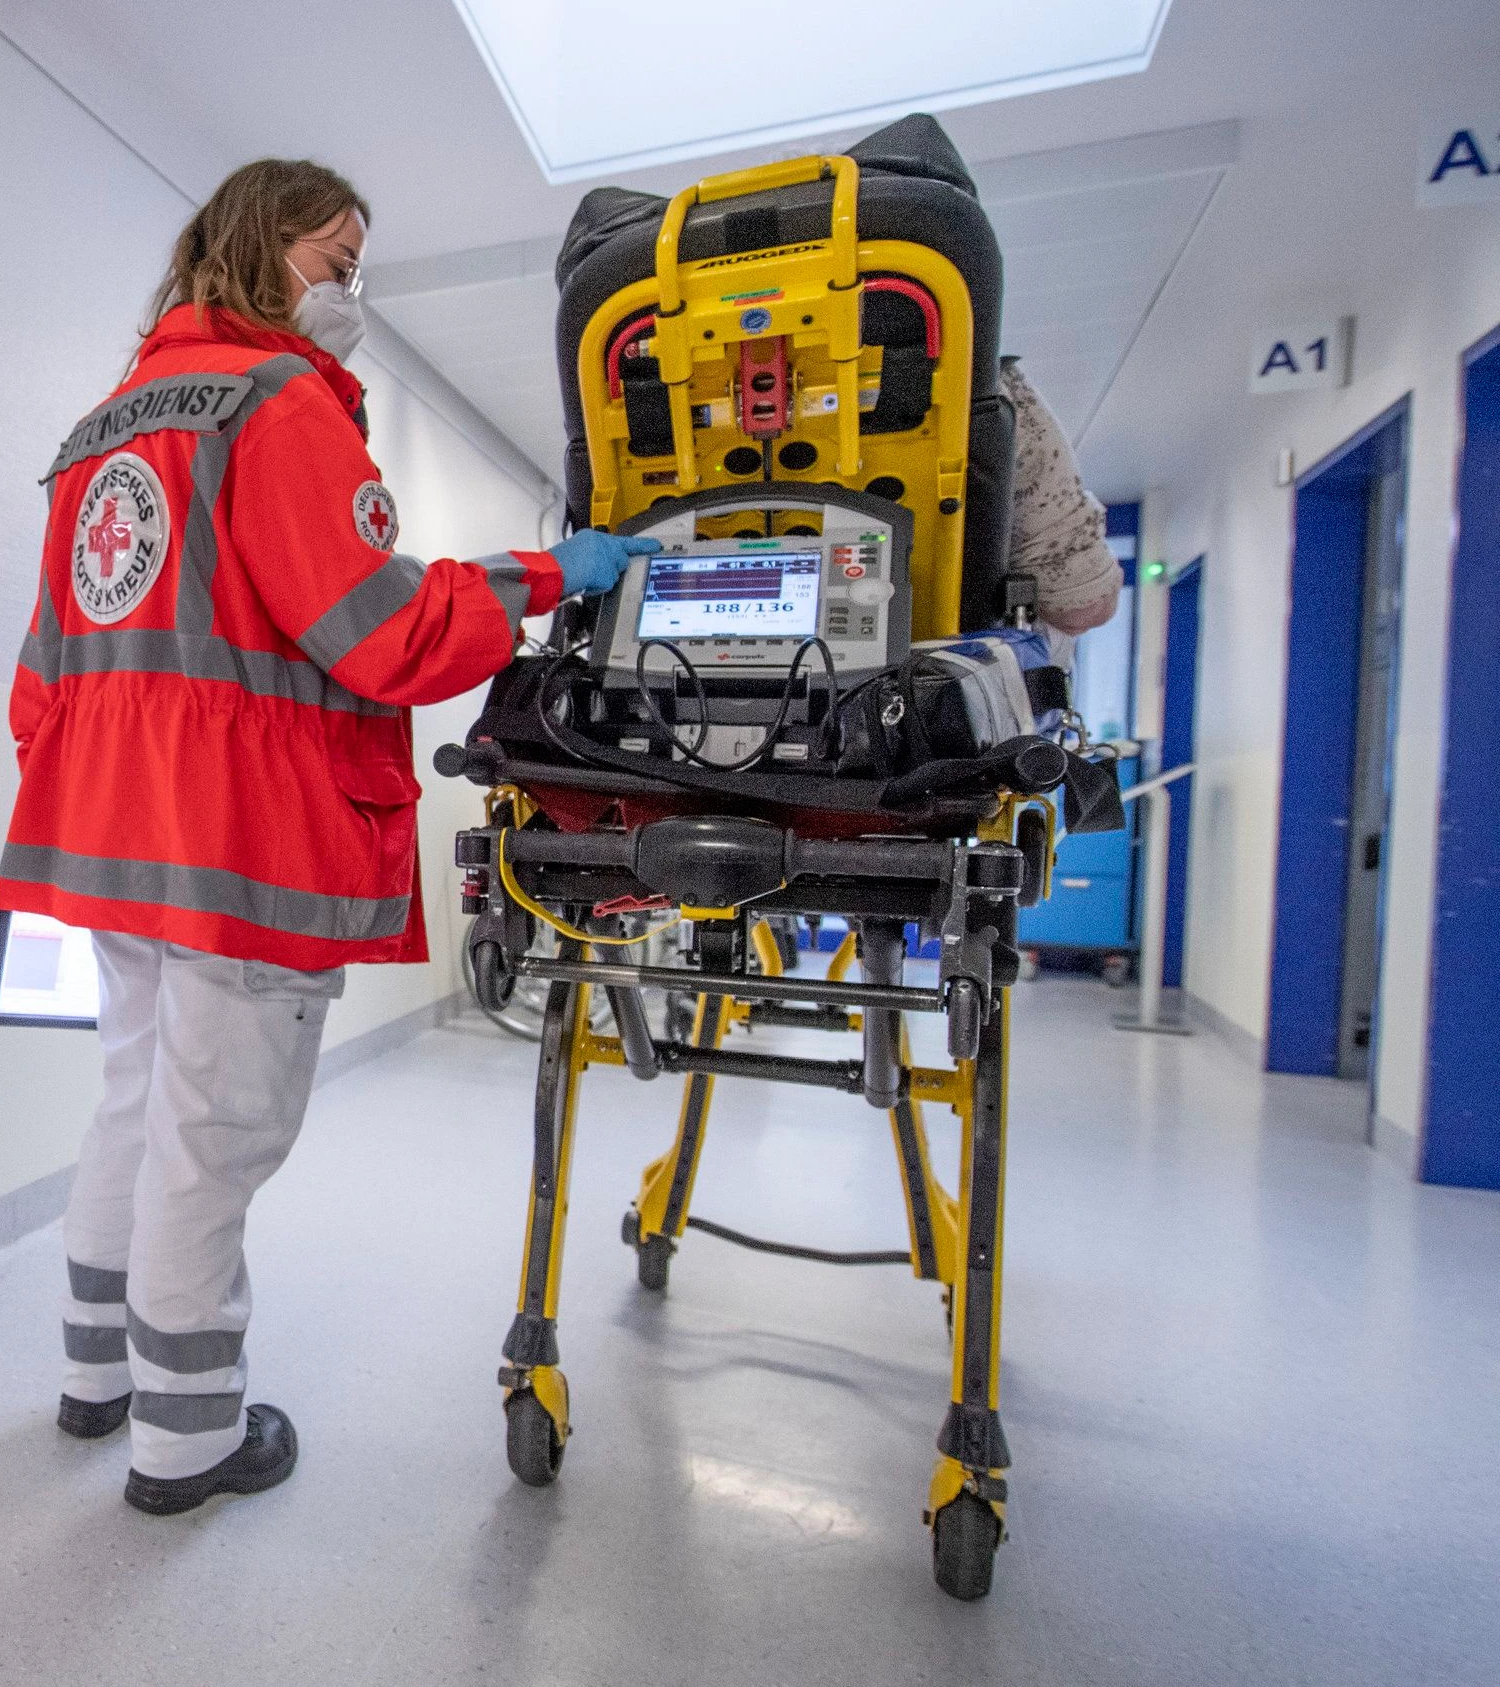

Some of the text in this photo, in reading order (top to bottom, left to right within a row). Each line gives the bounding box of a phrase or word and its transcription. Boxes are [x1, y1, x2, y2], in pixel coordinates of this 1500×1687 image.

[1428, 129, 1500, 183] A
[1260, 337, 1327, 377] A1
[80, 469, 155, 527] DEUTSCHES
[75, 539, 155, 607] ROTES KREUZ
[702, 602, 795, 614] 188/136
